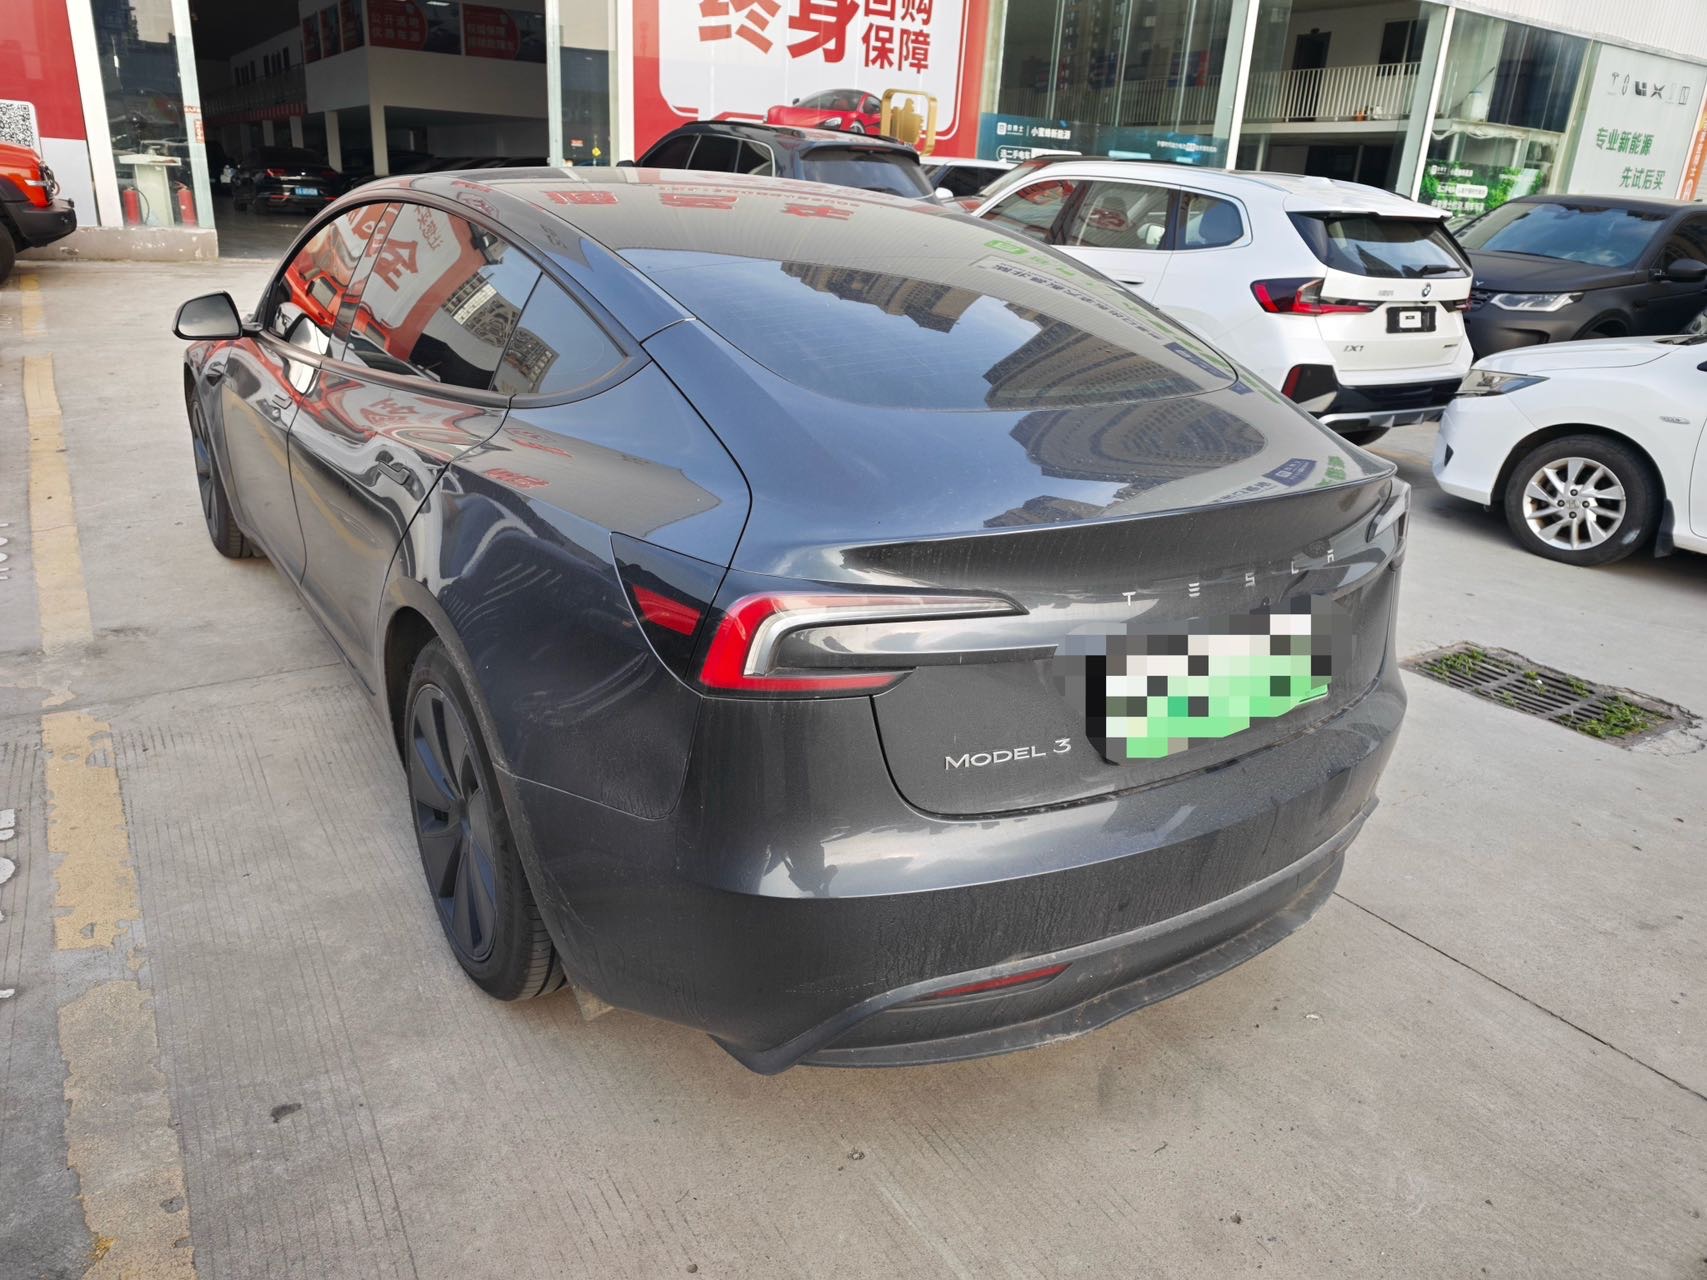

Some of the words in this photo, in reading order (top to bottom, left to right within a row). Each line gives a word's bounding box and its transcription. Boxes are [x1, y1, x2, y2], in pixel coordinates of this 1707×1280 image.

[862, 22, 931, 74] 保障
[1596, 127, 1655, 156] 专业新能源
[1619, 166, 1666, 190] 先试后买
[944, 745, 1047, 771] MODEL
[1052, 737, 1072, 754] 3
